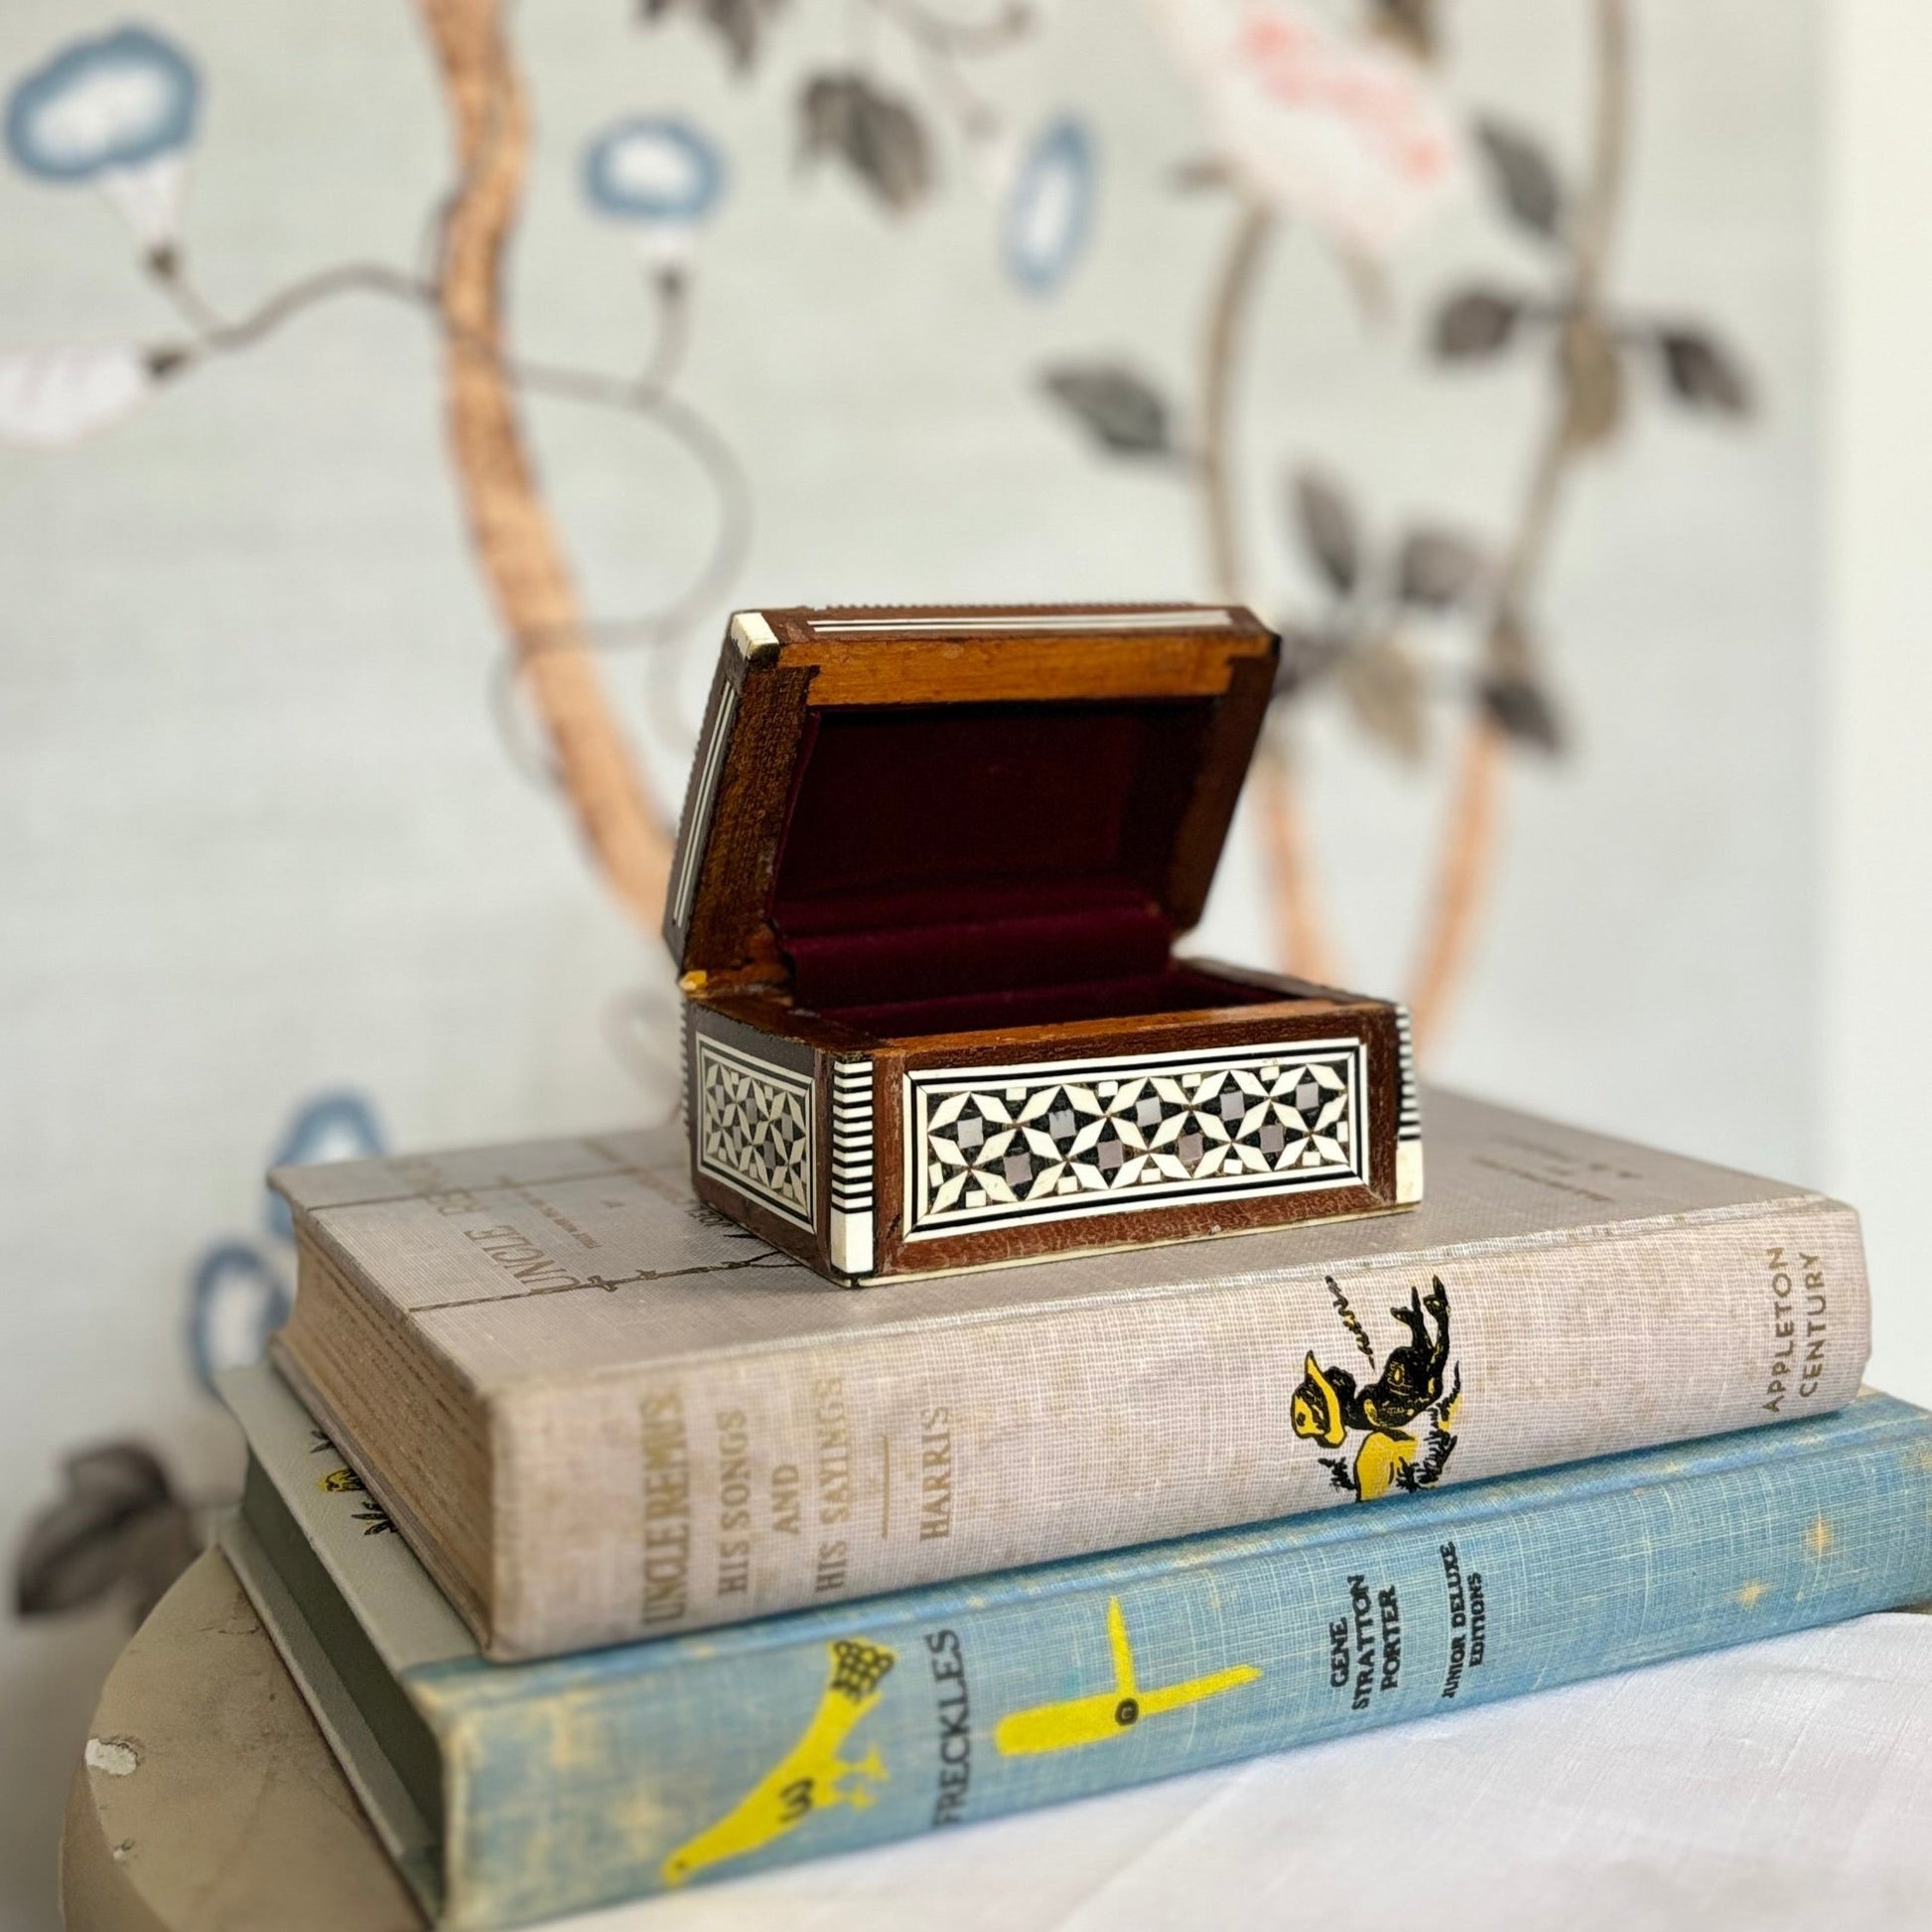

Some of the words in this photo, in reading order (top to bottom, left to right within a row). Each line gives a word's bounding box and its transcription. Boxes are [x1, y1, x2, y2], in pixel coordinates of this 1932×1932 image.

[463, 1223, 584, 1294] UNCLE
[1762, 1247, 1795, 1413] APPLETON
[1799, 1252, 1827, 1398] CENTURY
[640, 1392, 689, 1519] REMUS
[716, 1409, 751, 1532] SONGS
[771, 1463, 800, 1535] AND
[814, 1377, 850, 1525] SAYINGS
[919, 1406, 951, 1540] HARRIS
[641, 1522, 689, 1625] UNCLE
[718, 1539, 750, 1595] HIS
[815, 1540, 847, 1592] HIS
[1440, 1541, 1466, 1629] DELUXE
[1329, 1617, 1350, 1688] GENE
[1347, 1574, 1375, 1710] STRATTON
[1378, 1585, 1401, 1692] PORTER
[1442, 1634, 1466, 1699] JUNIOR
[1467, 1572, 1486, 1668] EDITIONS
[924, 1628, 970, 1828] FRECKLES
